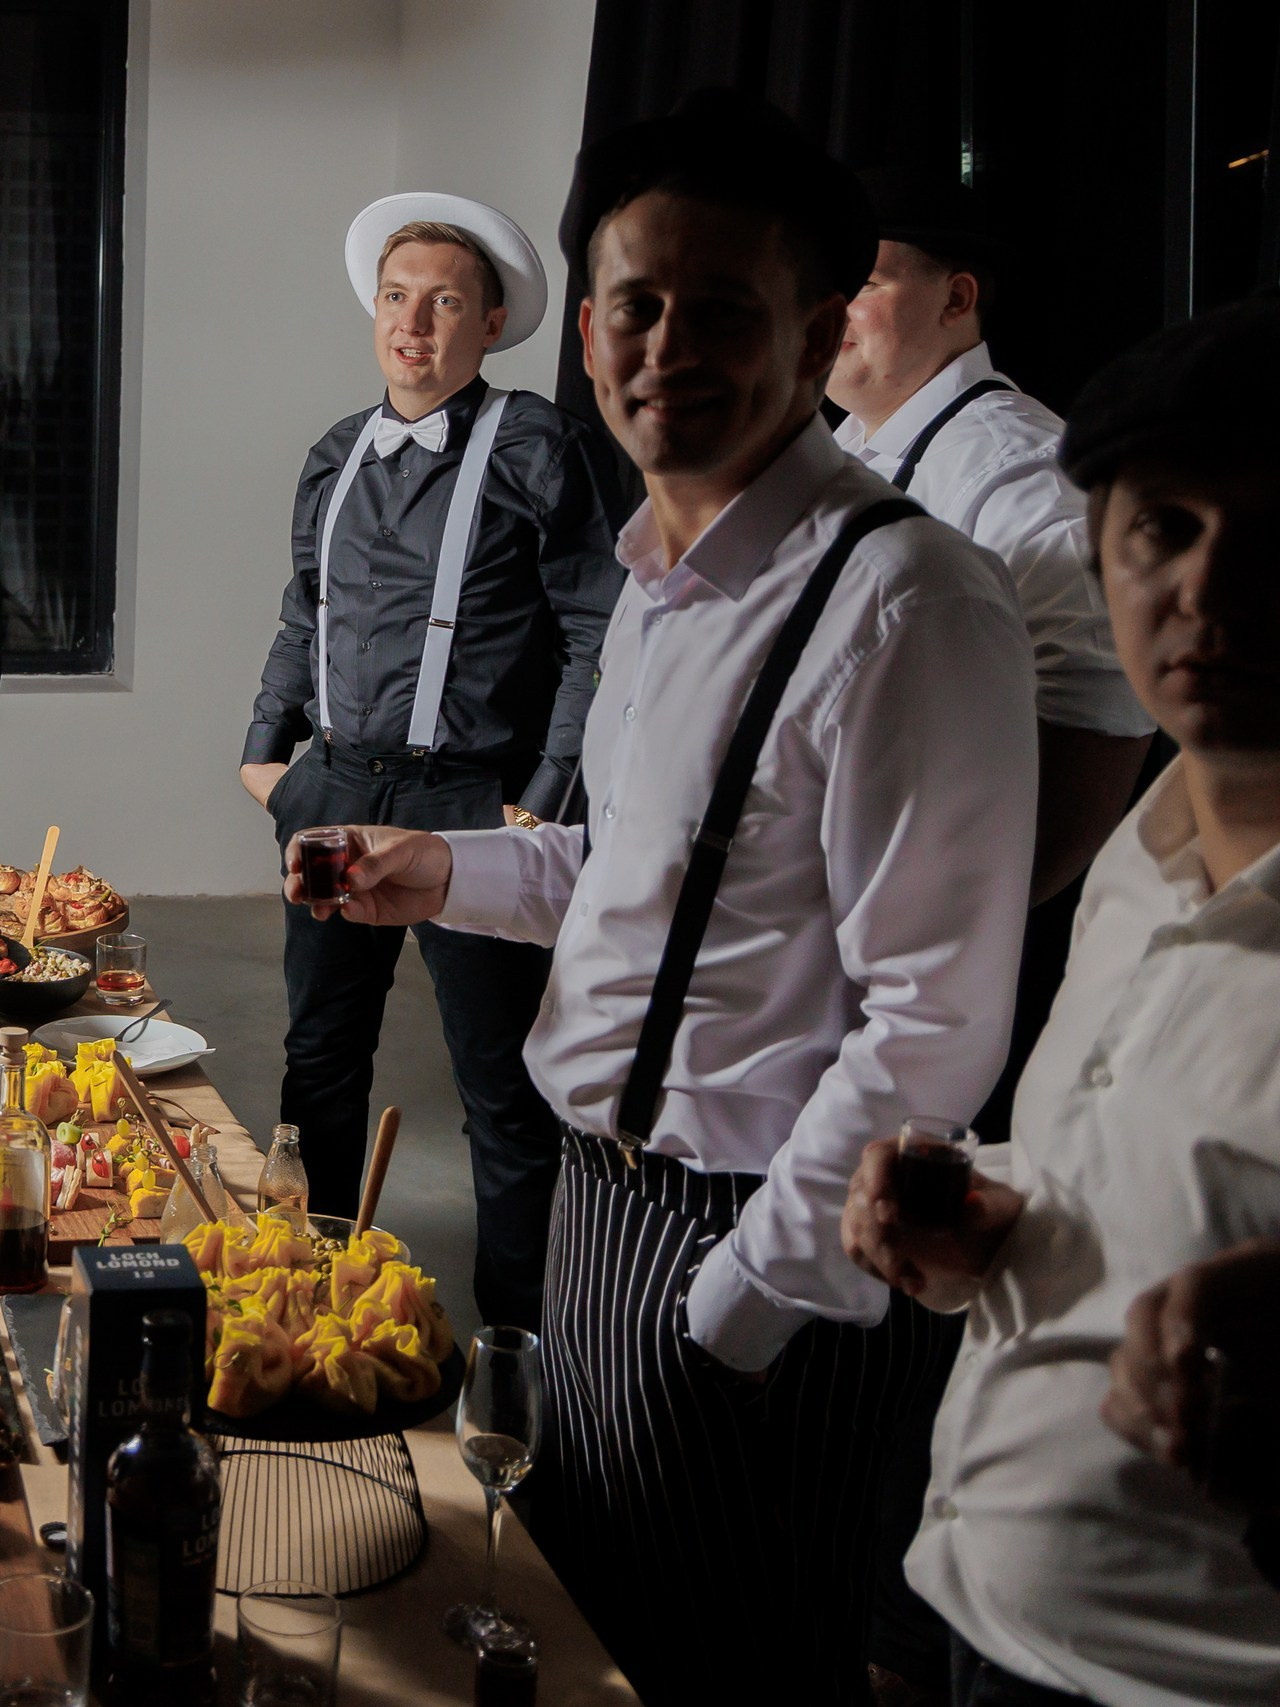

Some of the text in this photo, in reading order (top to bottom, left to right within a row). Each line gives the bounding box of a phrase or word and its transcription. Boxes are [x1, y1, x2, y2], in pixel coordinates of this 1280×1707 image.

[110, 1252, 160, 1261] LOCH
[96, 1258, 180, 1269] LOMOND
[133, 1270, 156, 1279] 12
[201, 1506, 219, 1531] LO
